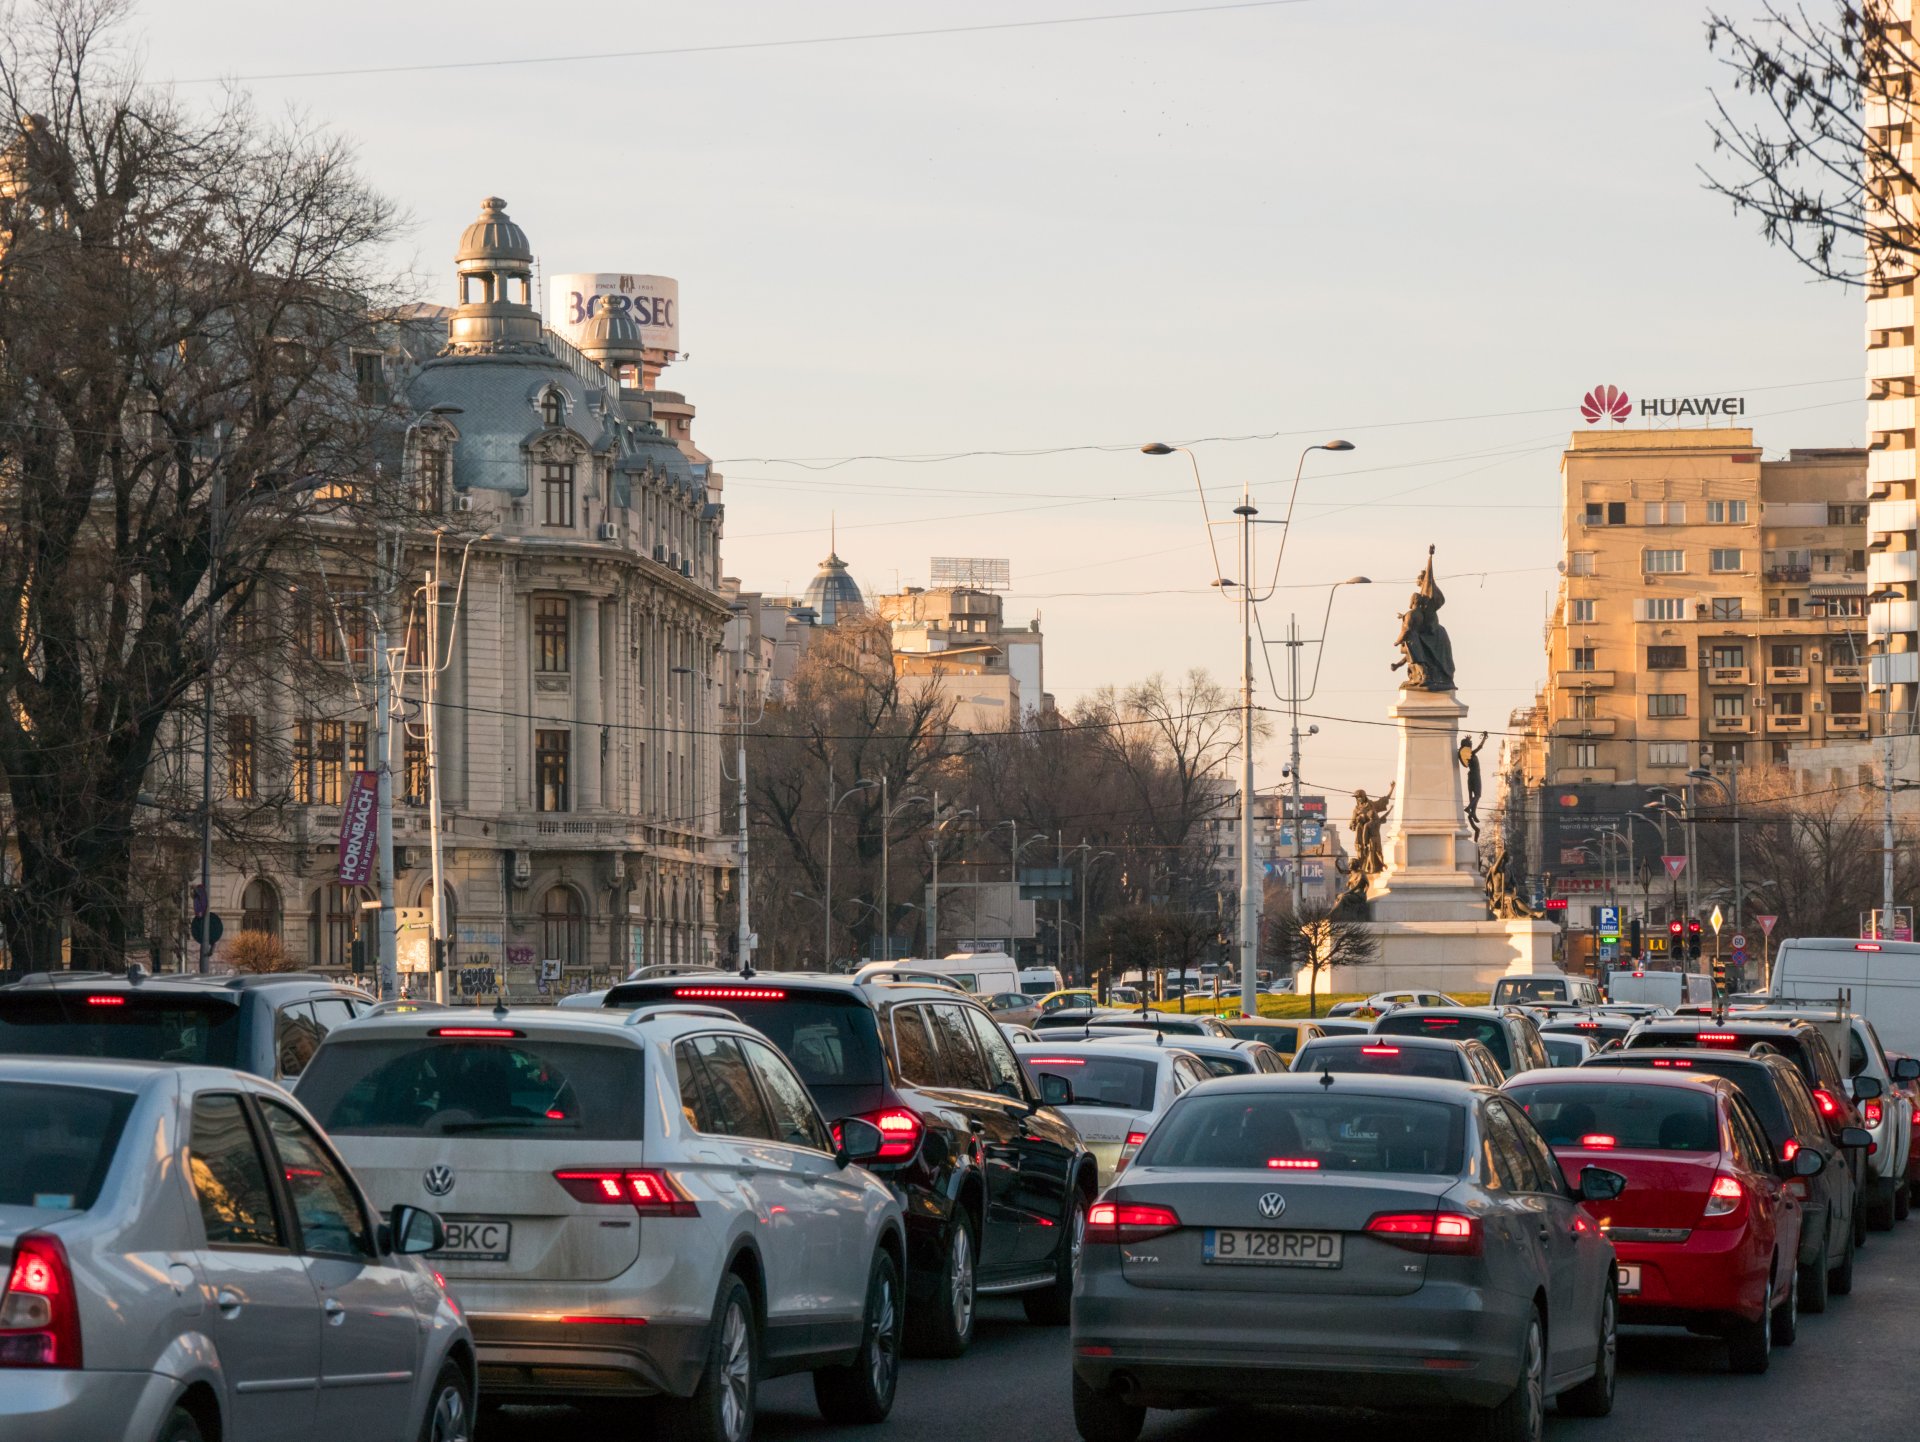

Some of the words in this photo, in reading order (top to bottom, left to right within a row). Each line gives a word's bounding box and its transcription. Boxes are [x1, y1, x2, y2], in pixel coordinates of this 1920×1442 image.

[1641, 397, 1745, 416] HUAWEI
[1285, 802, 1323, 811] NtBet
[340, 789, 374, 881] HORNBACH
[1274, 864, 1323, 878] MtLife
[1557, 879, 1611, 893] HOTEL
[446, 1224, 499, 1250] BKC
[1219, 1232, 1236, 1255] B
[1127, 1256, 1160, 1264] JETTA
